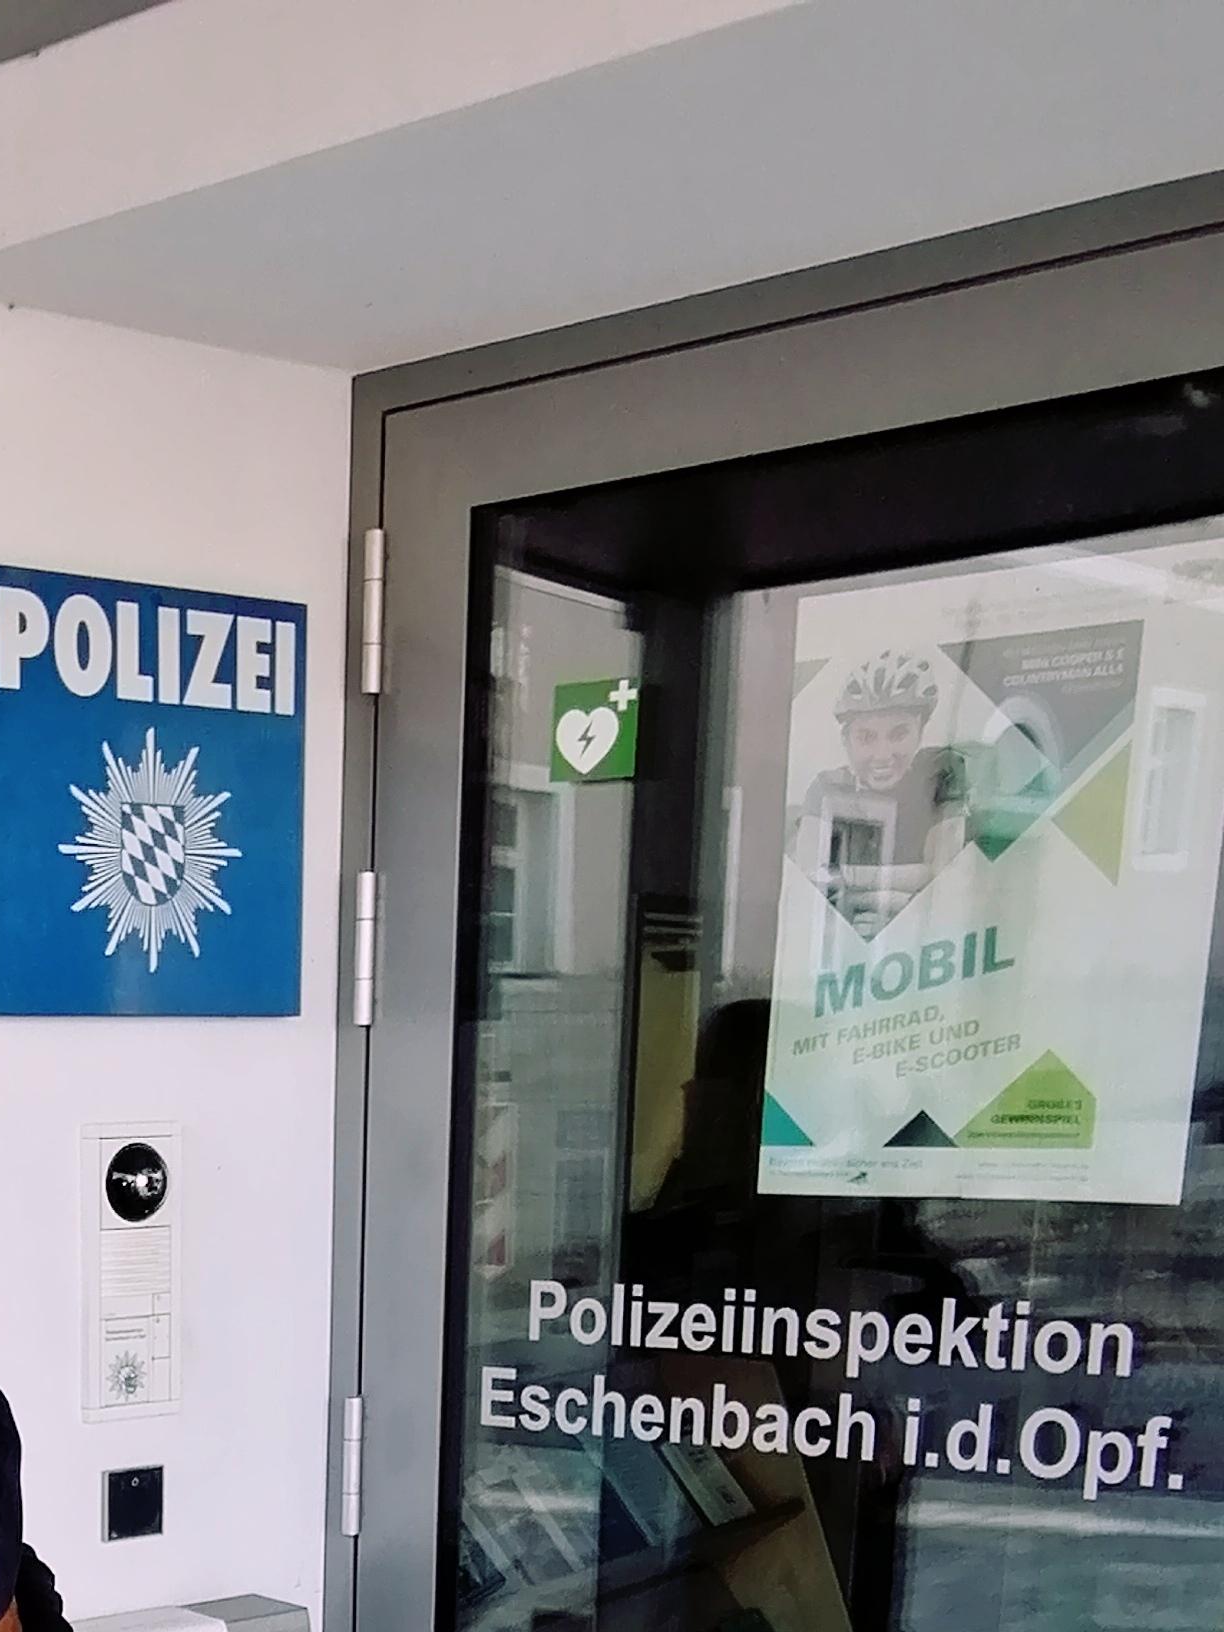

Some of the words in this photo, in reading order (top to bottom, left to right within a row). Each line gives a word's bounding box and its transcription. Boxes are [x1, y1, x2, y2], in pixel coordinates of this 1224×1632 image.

[814, 926, 1016, 1018] MOBIL
[792, 1032, 829, 1056] MIT
[836, 1004, 946, 1046] FAHRRAD,
[852, 1033, 921, 1066] E-BIKE
[929, 1019, 980, 1046] UND
[895, 1033, 1022, 1079] E-SCOOTER
[528, 1279, 1135, 1379] Polizeiinspektion
[480, 1366, 875, 1462] Eschenbach
[902, 1397, 1186, 1501] i.d.Opf.
